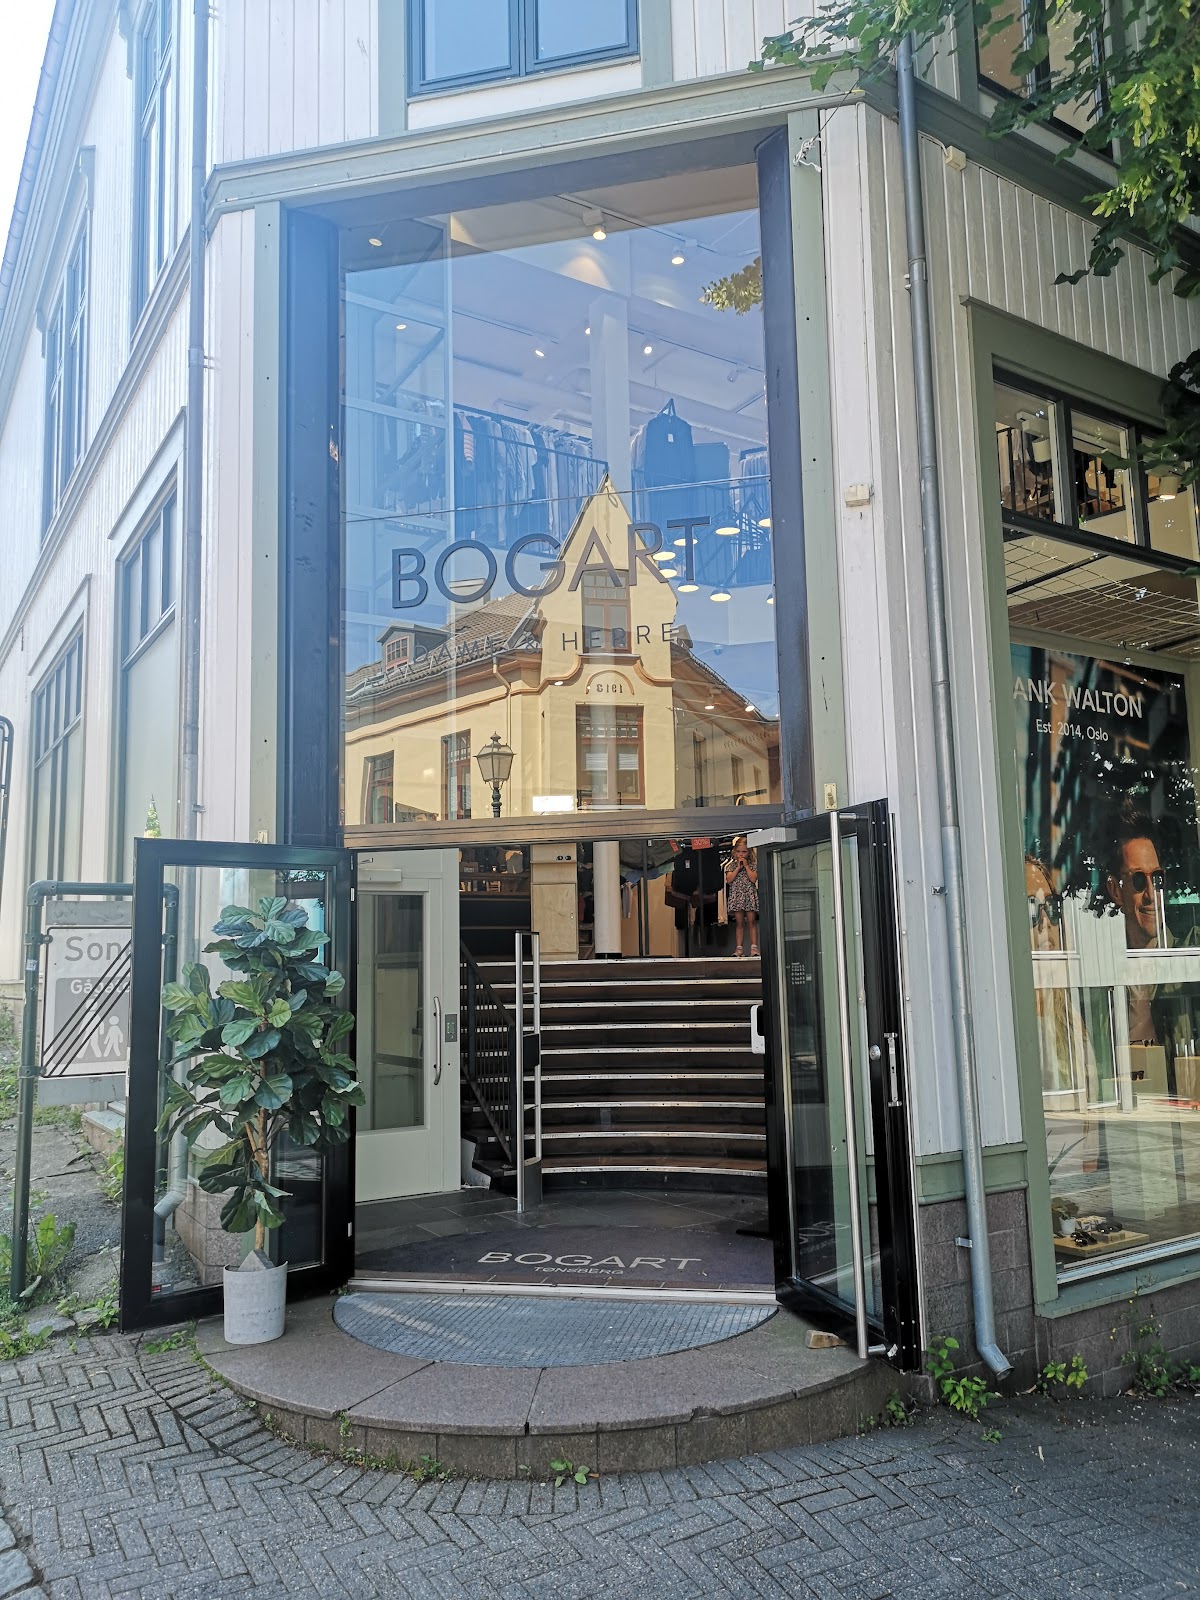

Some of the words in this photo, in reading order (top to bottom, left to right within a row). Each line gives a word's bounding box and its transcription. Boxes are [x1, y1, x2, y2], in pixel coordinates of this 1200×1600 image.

[391, 515, 712, 609] BOGART
[562, 622, 674, 652] HERRE
[1013, 676, 1058, 705] ANK
[1061, 683, 1143, 719] WALTON
[1035, 718, 1055, 734] Est.
[1057, 721, 1084, 740] 2014,
[1086, 726, 1109, 742] Oslo
[64, 935, 131, 961] Son
[477, 1252, 702, 1270] BOGART
[534, 1266, 624, 1275] TØNSBERG
